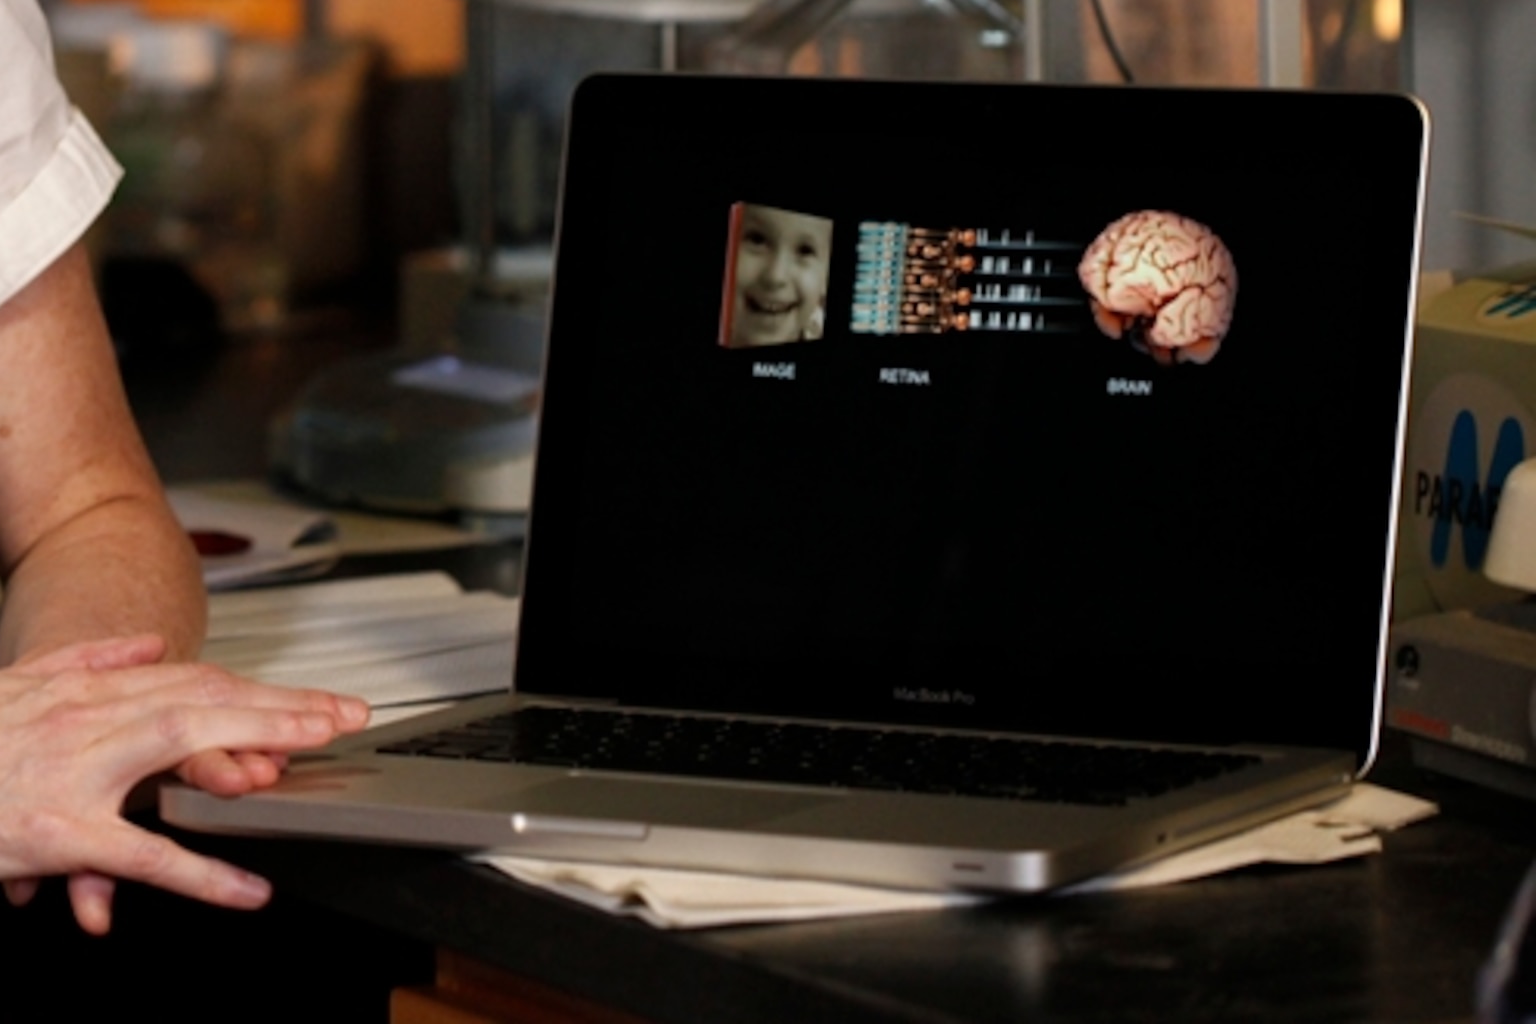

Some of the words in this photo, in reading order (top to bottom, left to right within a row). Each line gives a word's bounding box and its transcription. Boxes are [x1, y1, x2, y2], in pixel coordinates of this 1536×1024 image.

[753, 362, 796, 379] IMAGE
[879, 367, 931, 385] RETINA
[1107, 377, 1152, 396] BRAIN
